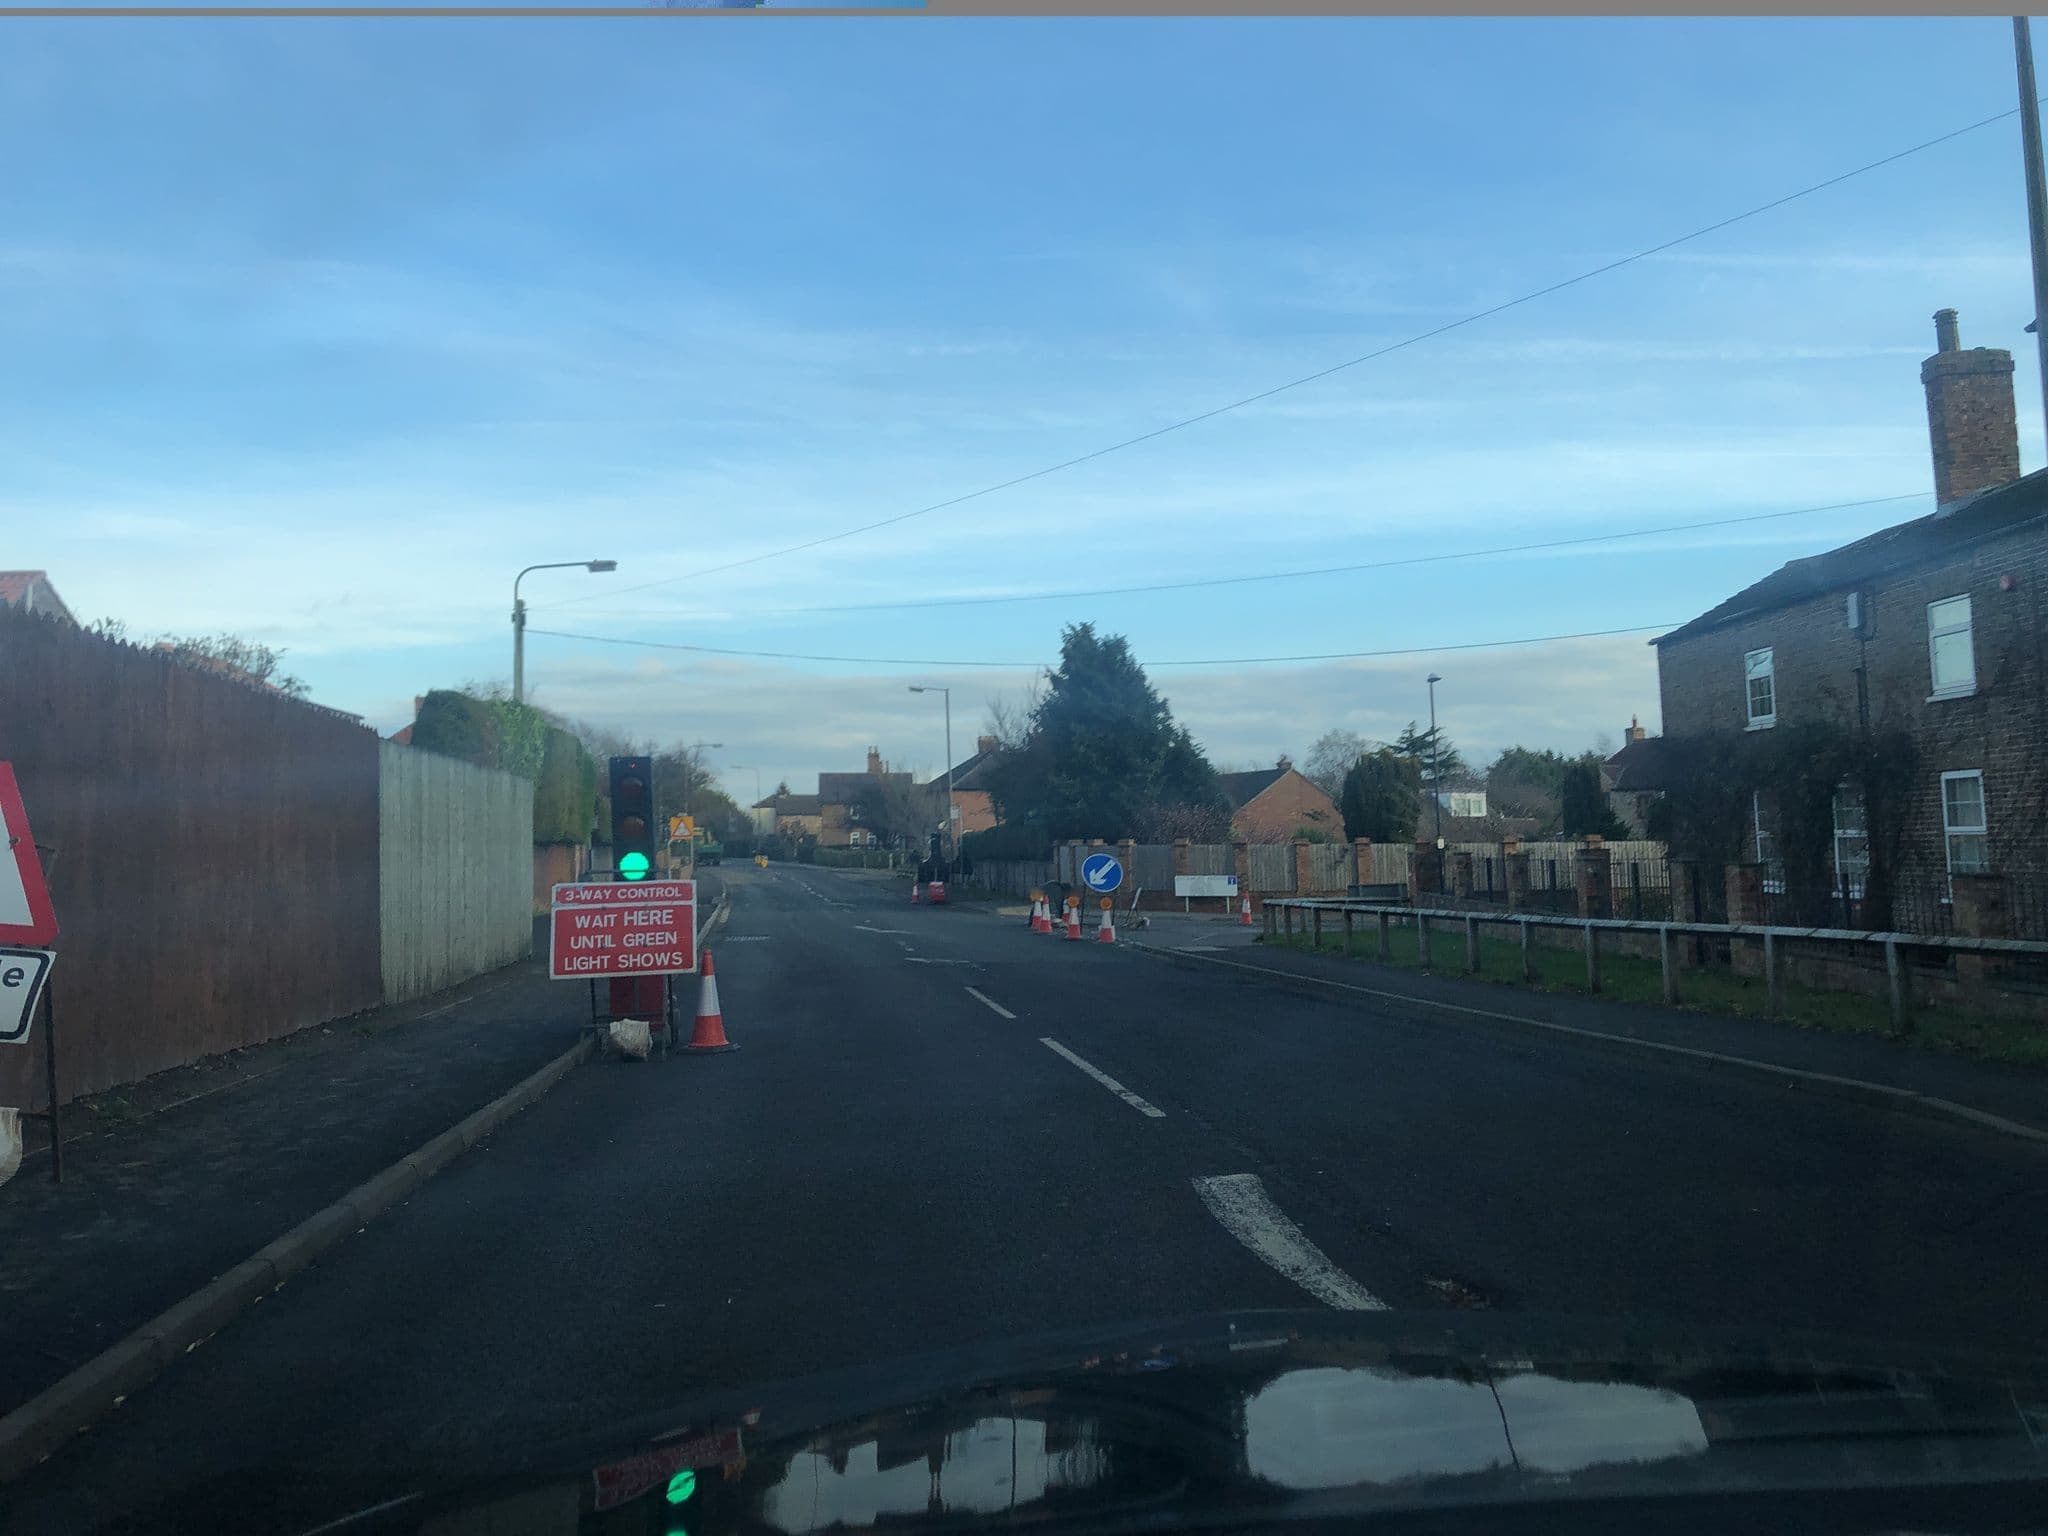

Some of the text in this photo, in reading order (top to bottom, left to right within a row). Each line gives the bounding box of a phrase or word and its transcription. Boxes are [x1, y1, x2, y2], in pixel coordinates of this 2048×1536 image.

[565, 887, 682, 902] 3-WAY CONTROL
[575, 909, 674, 929] WAIT HERE
[570, 931, 677, 950] UNTIL GREEN
[564, 952, 683, 971] LIGHT SHOWS
